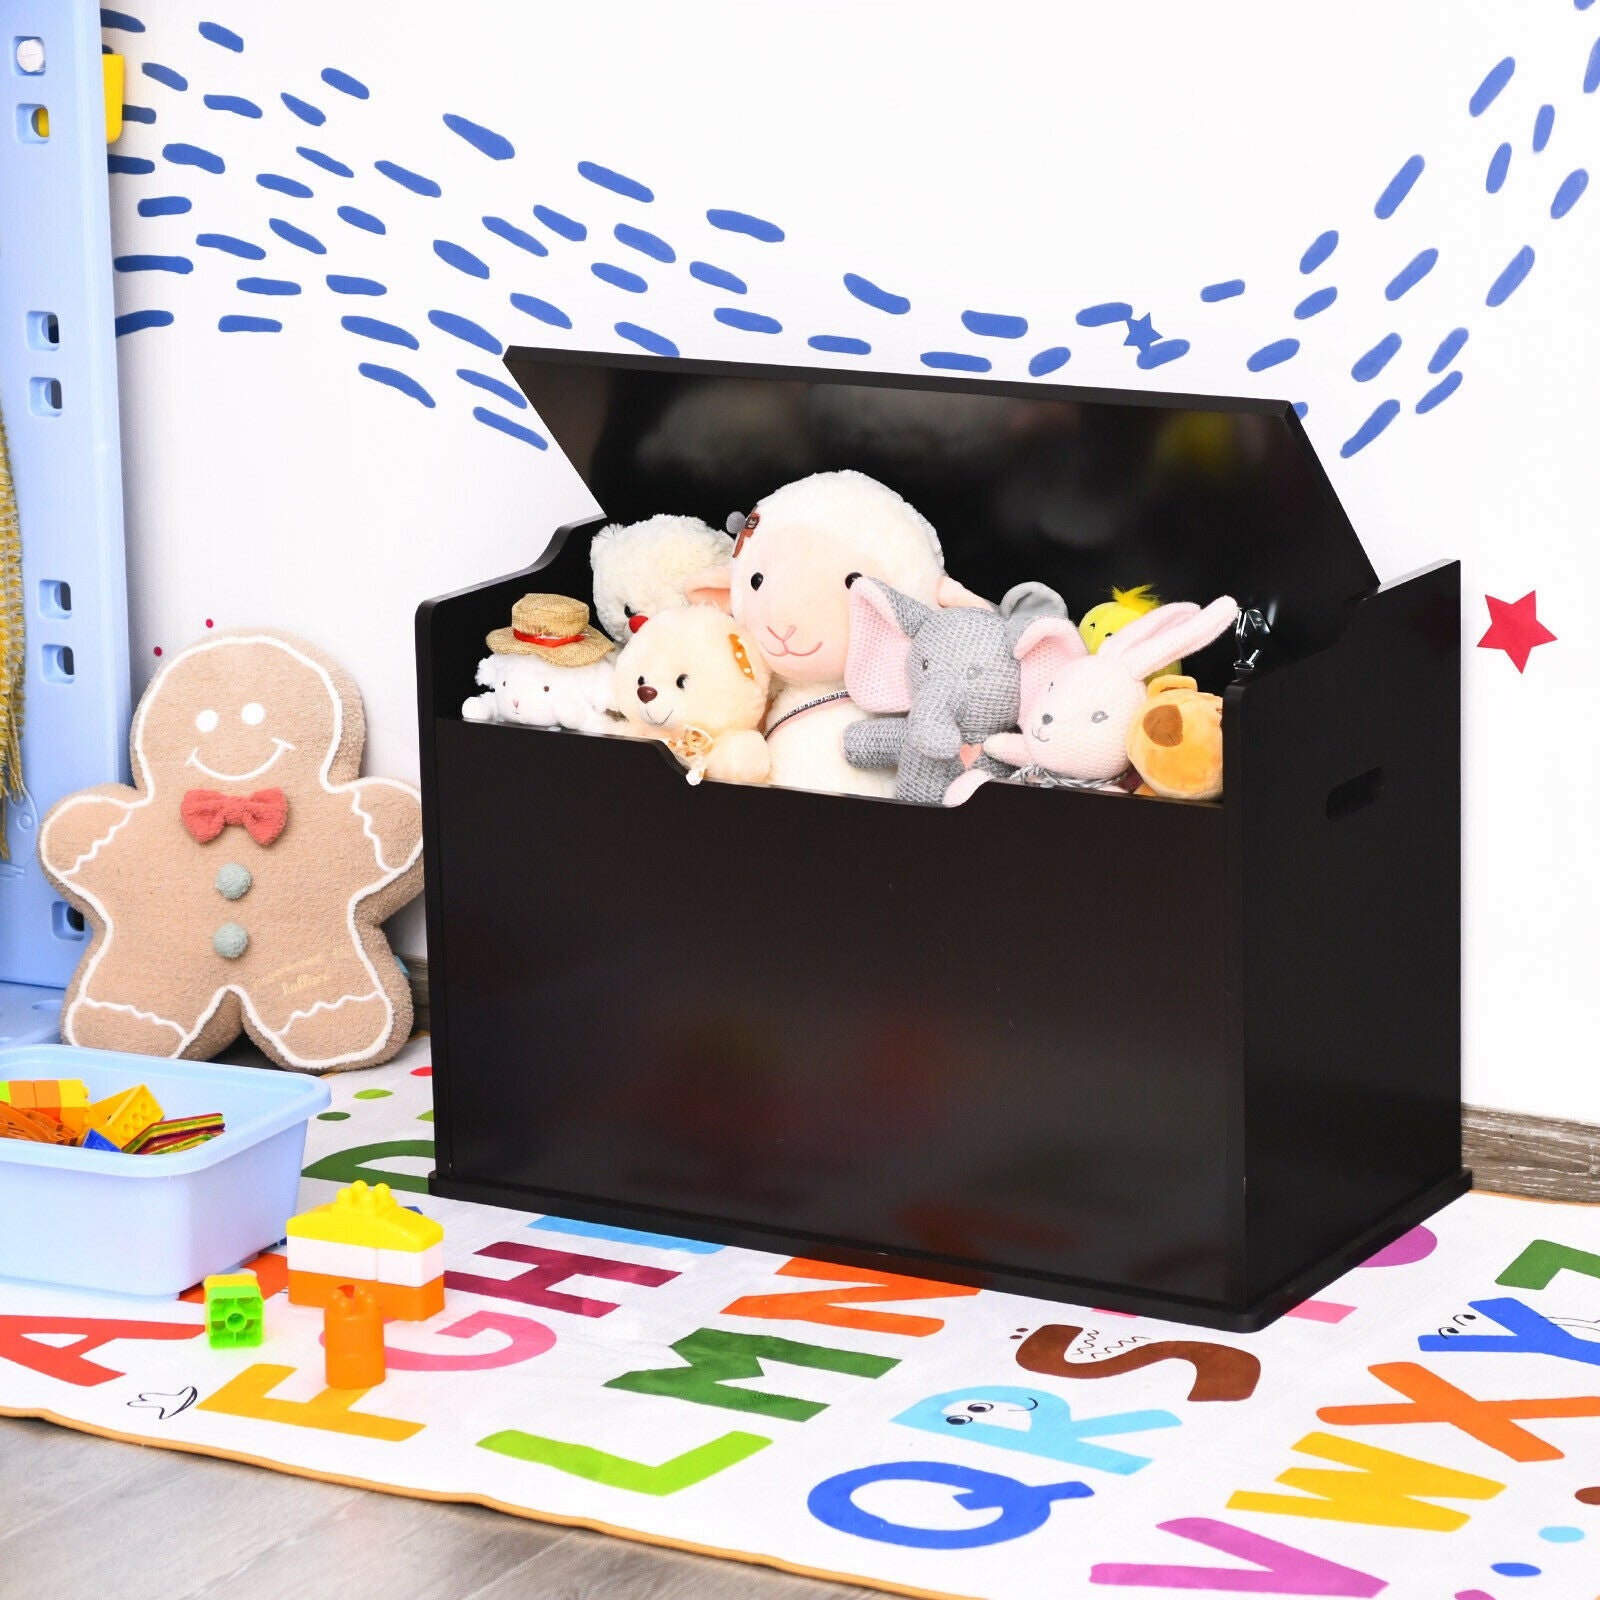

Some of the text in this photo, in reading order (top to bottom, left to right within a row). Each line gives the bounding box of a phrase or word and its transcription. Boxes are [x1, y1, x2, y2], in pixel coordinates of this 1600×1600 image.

[0, 1315, 206, 1386] A
[195, 1364, 426, 1441] F
[443, 1241, 683, 1318] H
[476, 1257, 982, 1496] L M N
[807, 1324, 1261, 1549] Q R S
[1089, 1297, 1600, 1598] V W X Y
